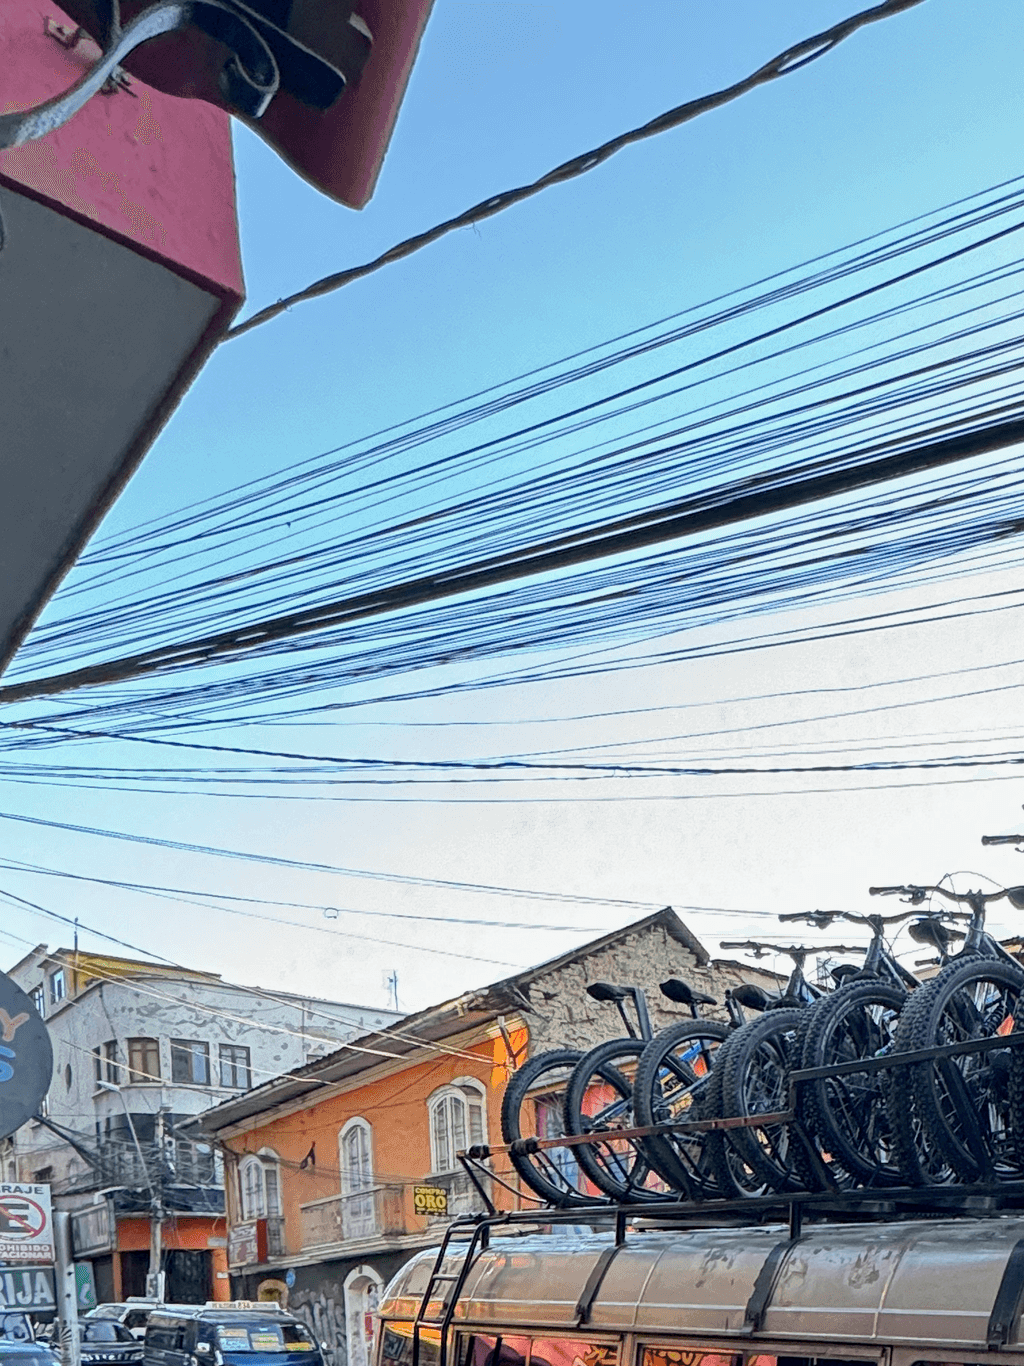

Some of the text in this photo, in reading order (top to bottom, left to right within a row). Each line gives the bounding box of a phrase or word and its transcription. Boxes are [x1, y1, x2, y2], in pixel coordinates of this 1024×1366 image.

[0, 1185, 44, 1195] RAJE
[415, 1187, 447, 1196] COMPRO
[415, 1195, 447, 1209] ORO
